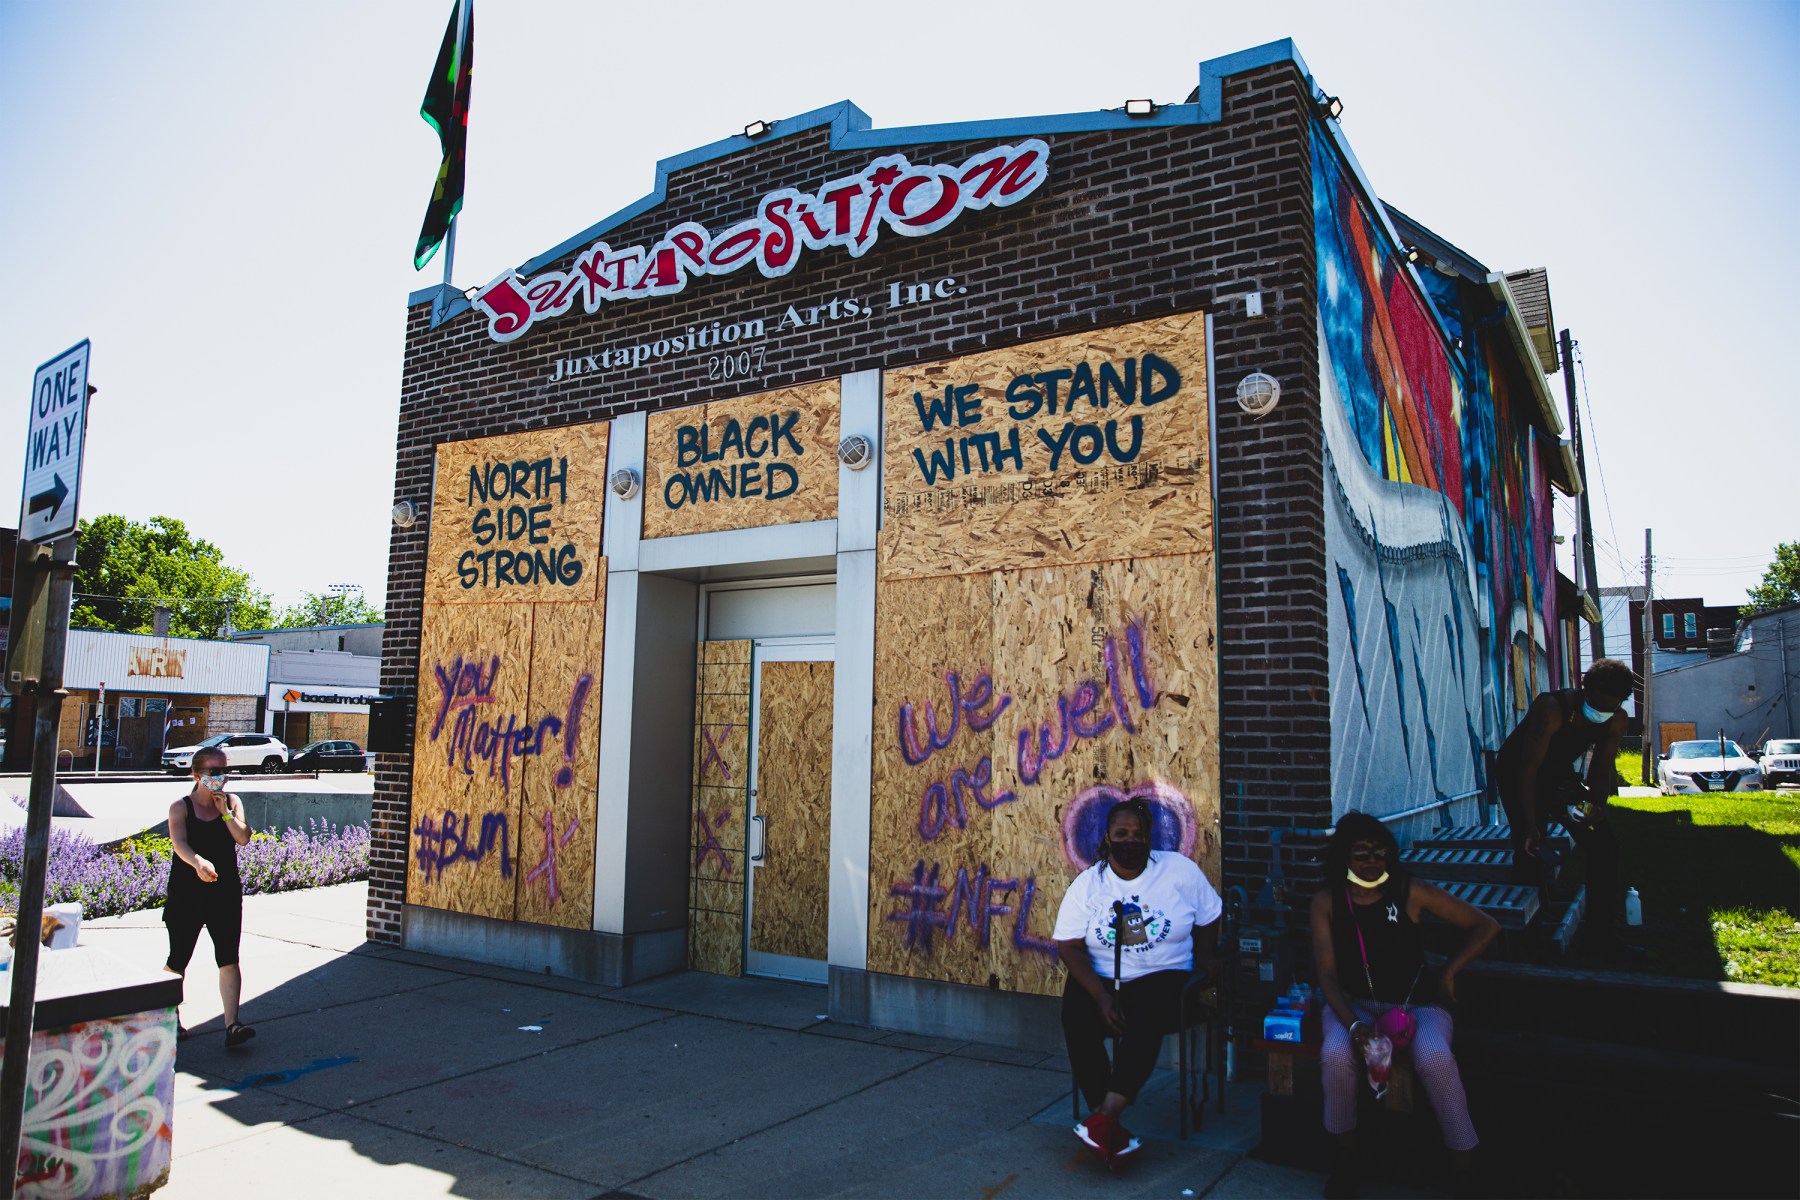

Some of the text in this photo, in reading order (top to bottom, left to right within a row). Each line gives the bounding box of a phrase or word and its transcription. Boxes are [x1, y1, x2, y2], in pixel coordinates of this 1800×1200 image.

[549, 271, 969, 382] Juxtaposition Arts, Inc.
[38, 358, 82, 419] ONE
[707, 345, 768, 382] 2007
[913, 352, 1181, 433] WE STAND
[32, 411, 79, 472] WAY
[677, 411, 804, 468] BLACK
[913, 414, 1144, 486] WITH YOU
[468, 456, 568, 507] NORTH
[664, 462, 799, 510] OWNED
[1022, 482, 1033, 500] D3
[471, 504, 552, 546] SIDE
[458, 543, 583, 589] STRONG
[919, 623, 1156, 841] are well
[413, 808, 515, 884] #BLM
[886, 859, 1059, 961] #NFL
[1094, 927, 1116, 949] RUST
[1135, 942, 1154, 953] THE
[1155, 919, 1171, 943] CREW
